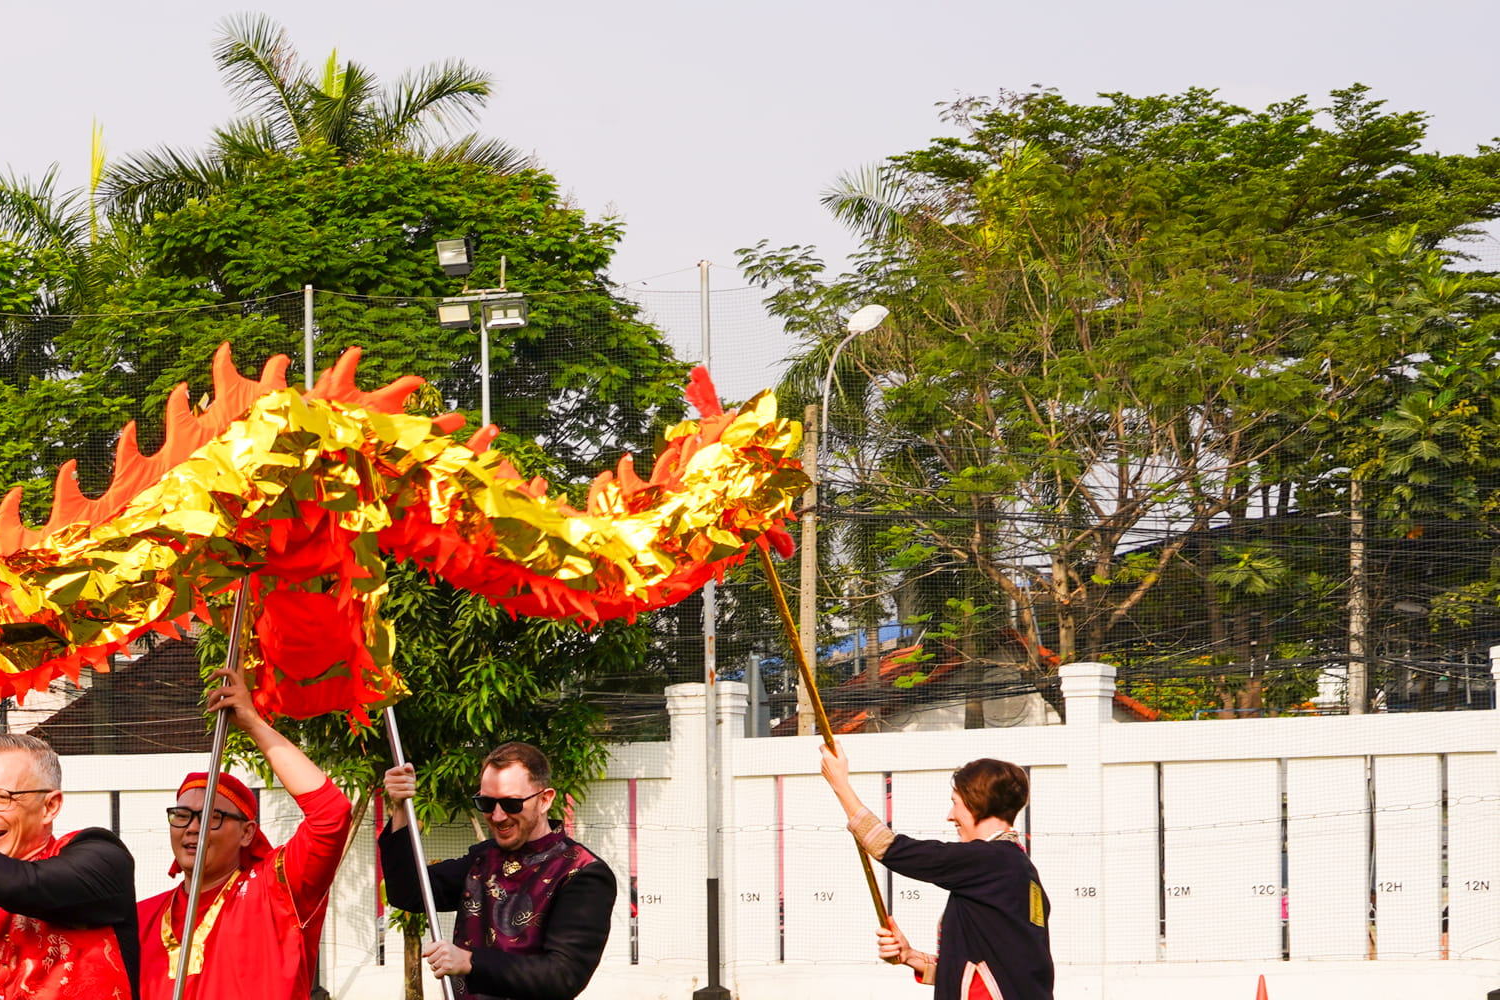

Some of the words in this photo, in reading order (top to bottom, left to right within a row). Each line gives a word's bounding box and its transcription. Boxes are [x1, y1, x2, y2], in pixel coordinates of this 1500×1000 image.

[1167, 886, 1191, 896] 12M
[1251, 884, 1275, 895] 12C
[1378, 882, 1403, 892] 12H
[1464, 881, 1490, 892] 12N
[813, 892, 834, 902] 13V
[899, 890, 921, 900] 13S
[1074, 887, 1097, 897] 13B
[640, 894, 662, 904] 13H
[740, 892, 761, 903] 13N
